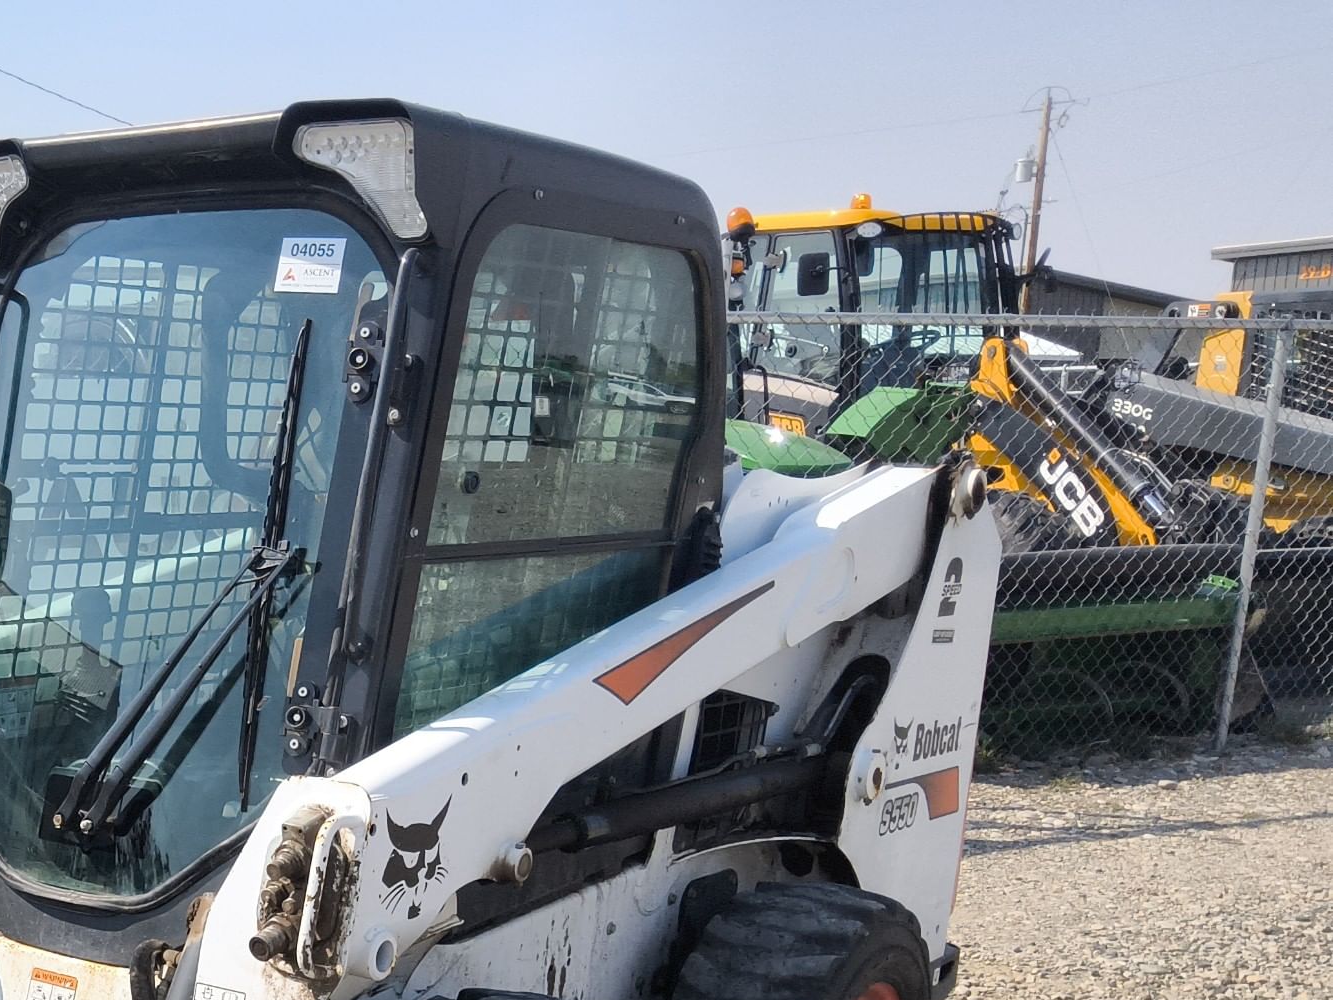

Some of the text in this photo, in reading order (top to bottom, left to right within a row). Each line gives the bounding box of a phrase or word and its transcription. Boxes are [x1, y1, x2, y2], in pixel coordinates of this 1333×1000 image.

[290, 243, 336, 257] 04055
[303, 268, 335, 277] ASCENT
[1111, 398, 1154, 421] 330G
[1039, 459, 1105, 537] JCB
[941, 583, 963, 597] SPEED
[912, 716, 962, 761] Bobcat
[878, 791, 919, 836] S550
